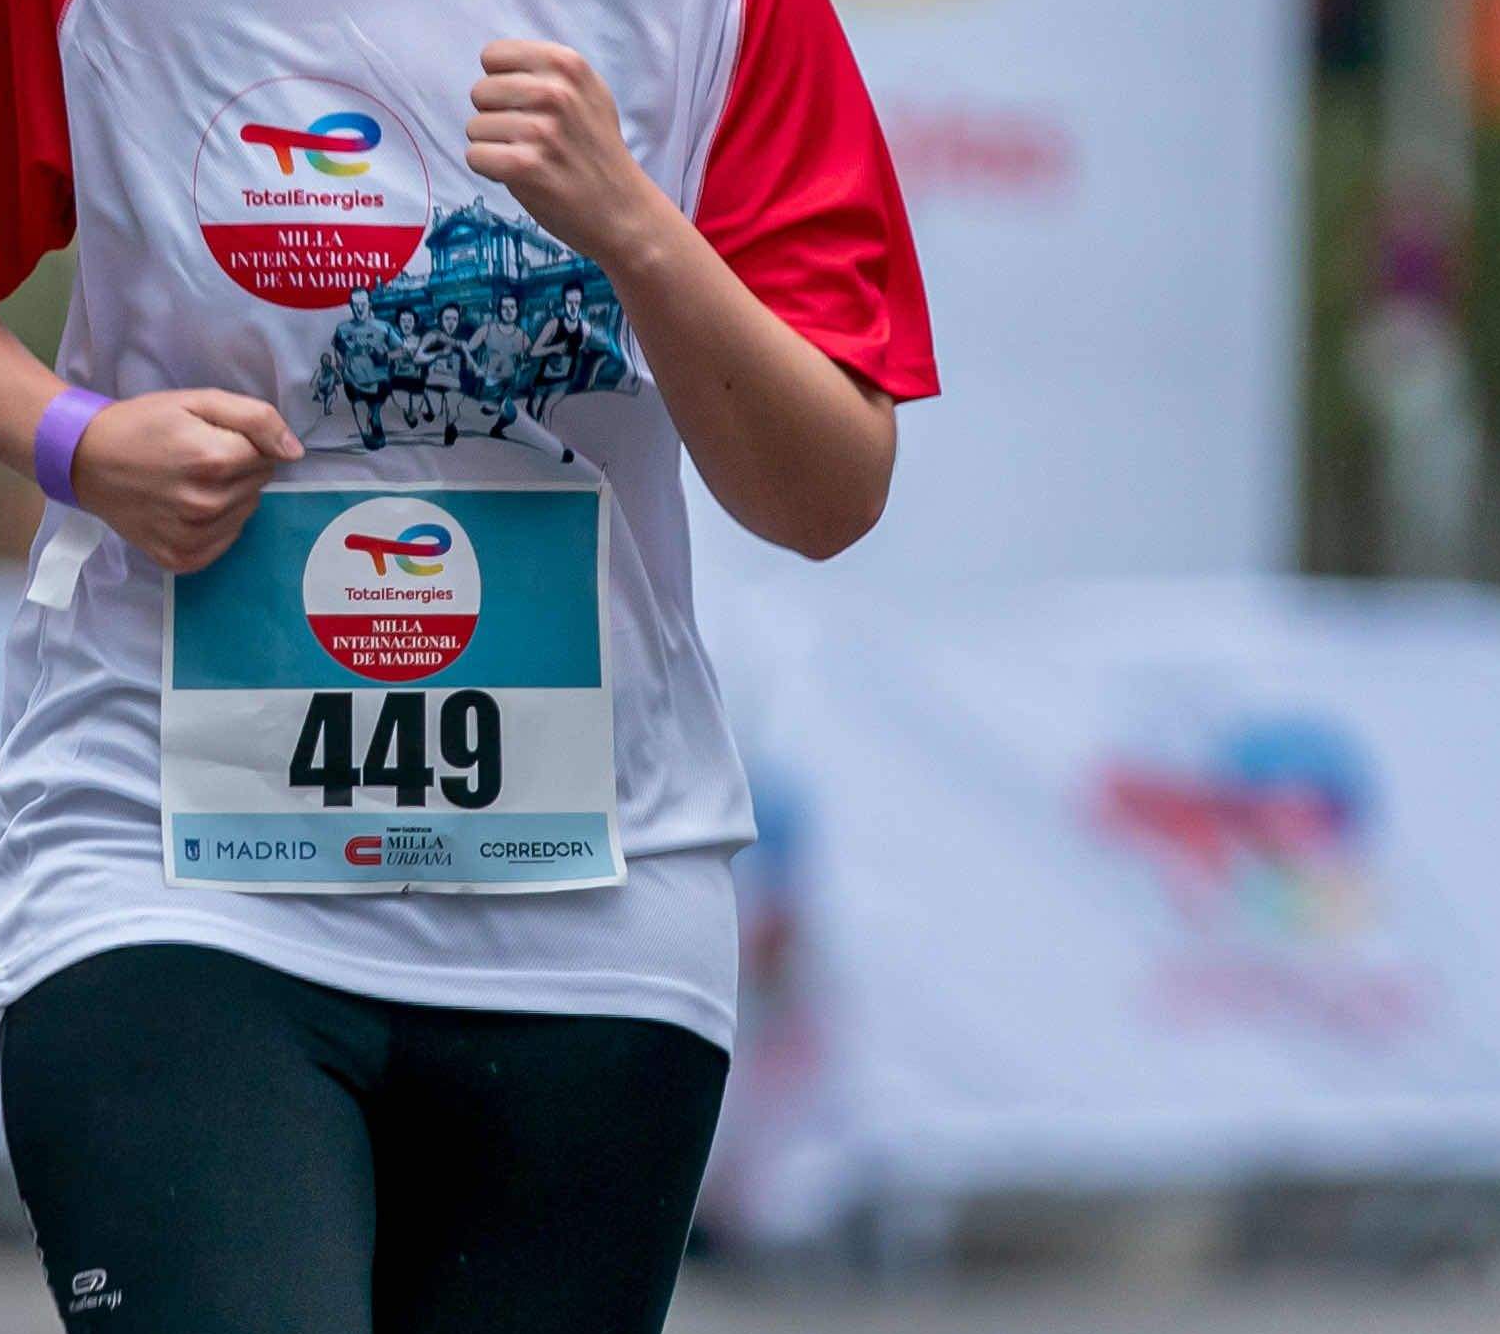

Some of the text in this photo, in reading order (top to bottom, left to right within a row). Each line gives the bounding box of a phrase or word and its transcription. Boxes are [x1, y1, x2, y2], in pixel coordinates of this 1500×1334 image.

[242, 189, 384, 211] TotalEnergies
[278, 230, 344, 247] MILLA
[256, 271, 370, 288] DE MADRID
[345, 587, 453, 603] TotalEnergies
[372, 620, 423, 633] MILLA
[353, 651, 443, 666] DE MADRID
[289, 689, 502, 809] 449
[216, 841, 317, 860] MADRID
[387, 836, 444, 849] MILLA
[386, 852, 452, 866] URBANA
